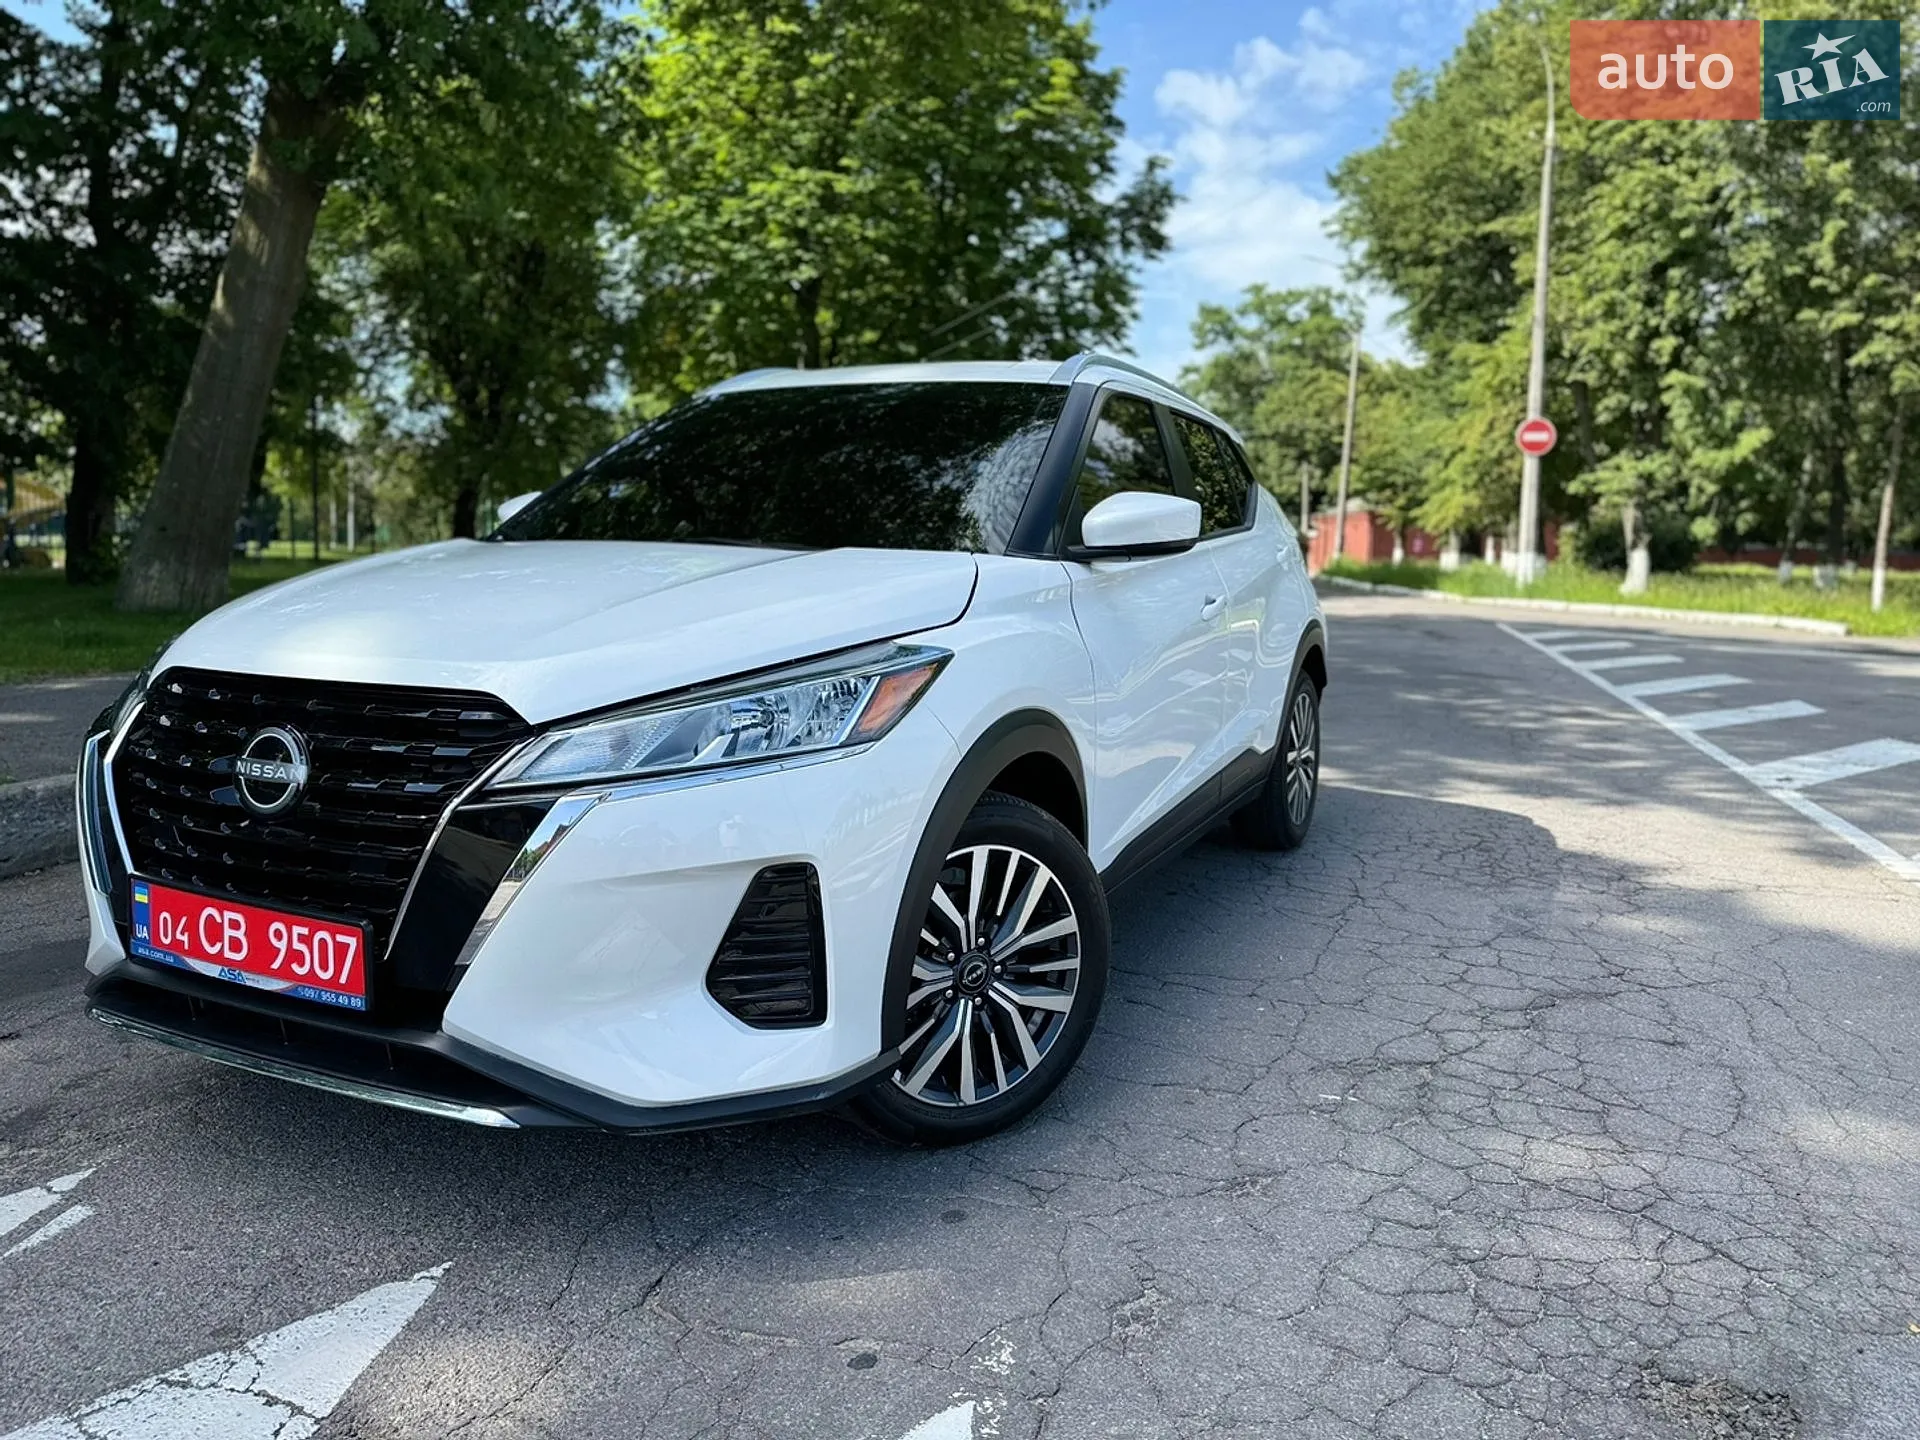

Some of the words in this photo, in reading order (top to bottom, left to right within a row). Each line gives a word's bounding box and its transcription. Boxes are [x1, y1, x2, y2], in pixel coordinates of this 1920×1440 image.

[236, 760, 304, 781] NISSAN
[135, 925, 150, 940] UA
[158, 911, 189, 950] 04
[198, 906, 249, 961] CB
[267, 921, 358, 985] 9507
[218, 967, 247, 984] ASA
[338, 994, 348, 1005] 49
[350, 996, 361, 1008] 89
